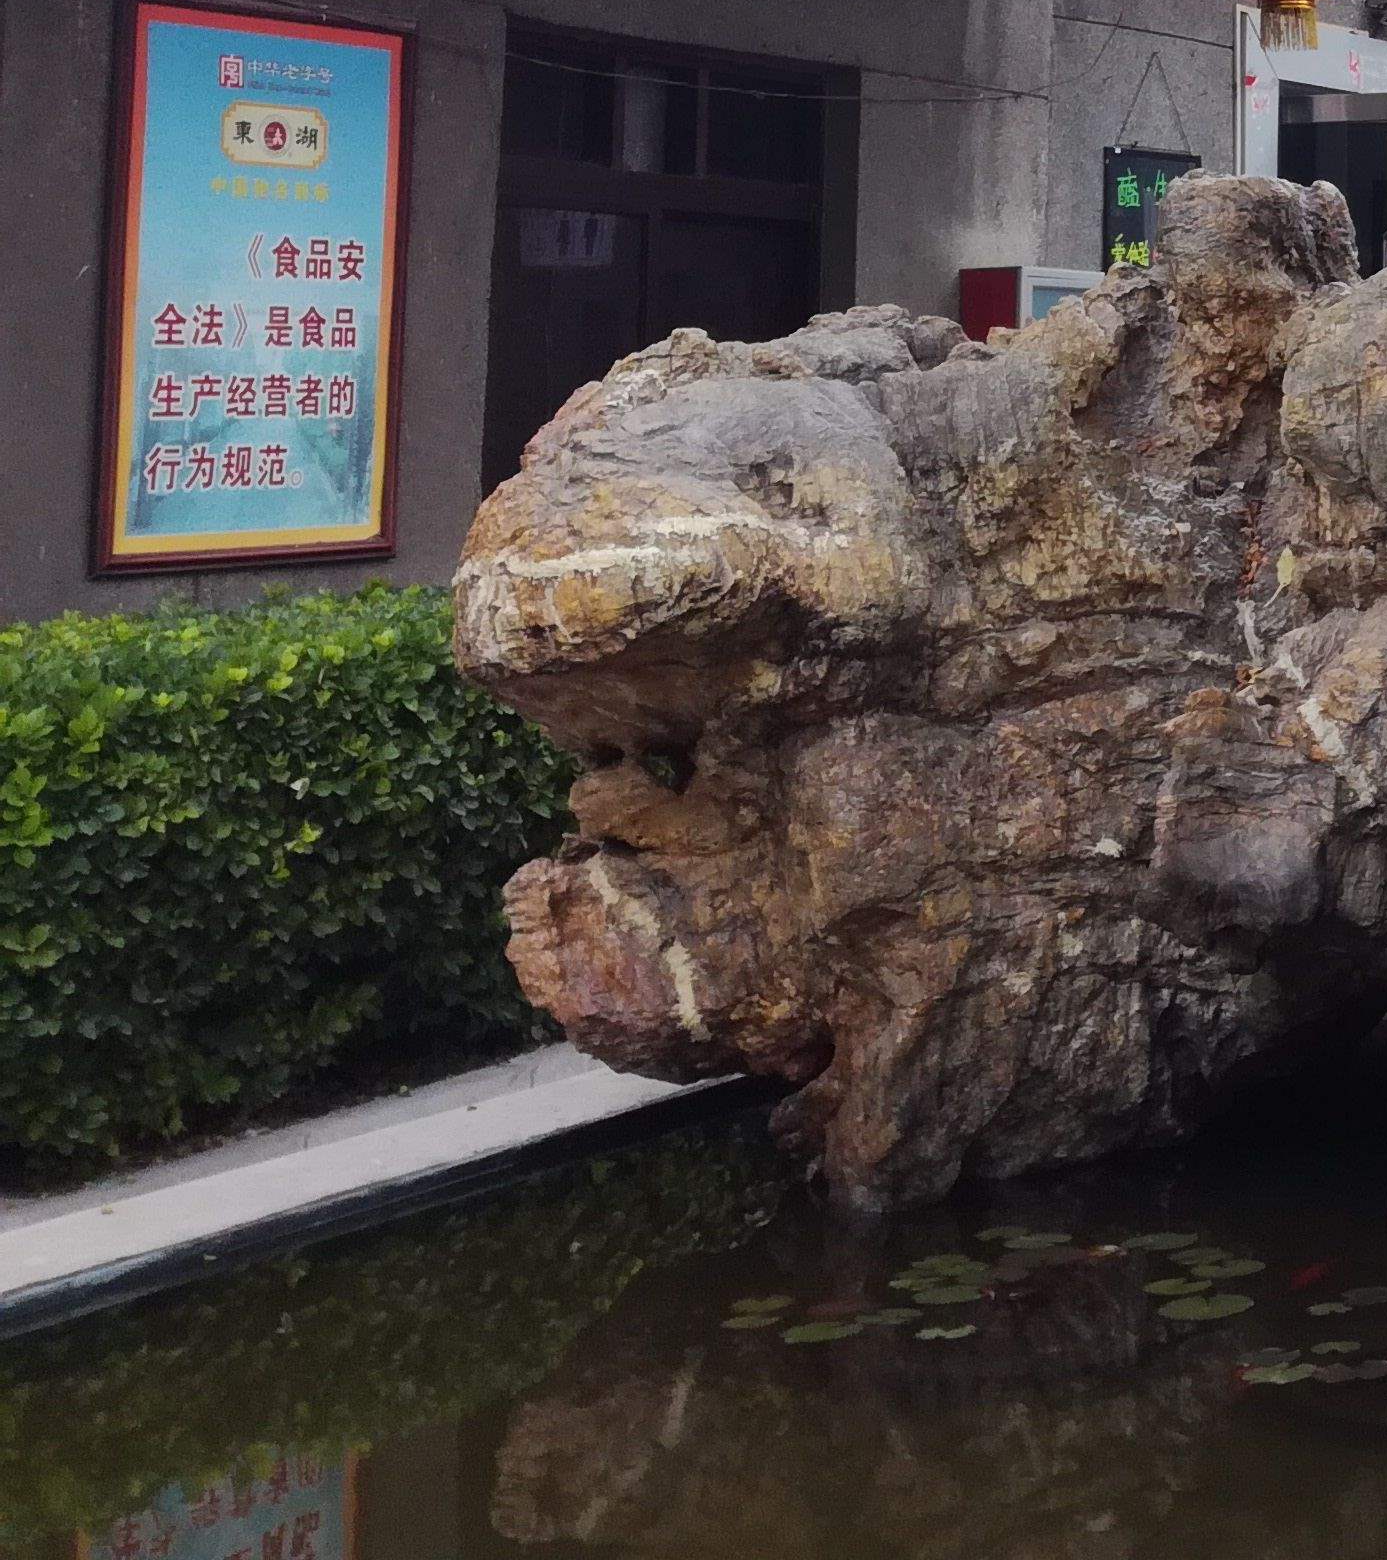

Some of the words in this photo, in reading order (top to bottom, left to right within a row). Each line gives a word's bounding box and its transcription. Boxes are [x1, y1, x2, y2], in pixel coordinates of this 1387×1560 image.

[153, 302, 357, 349] 全法》是食品
[151, 373, 356, 418] 生产经营者的
